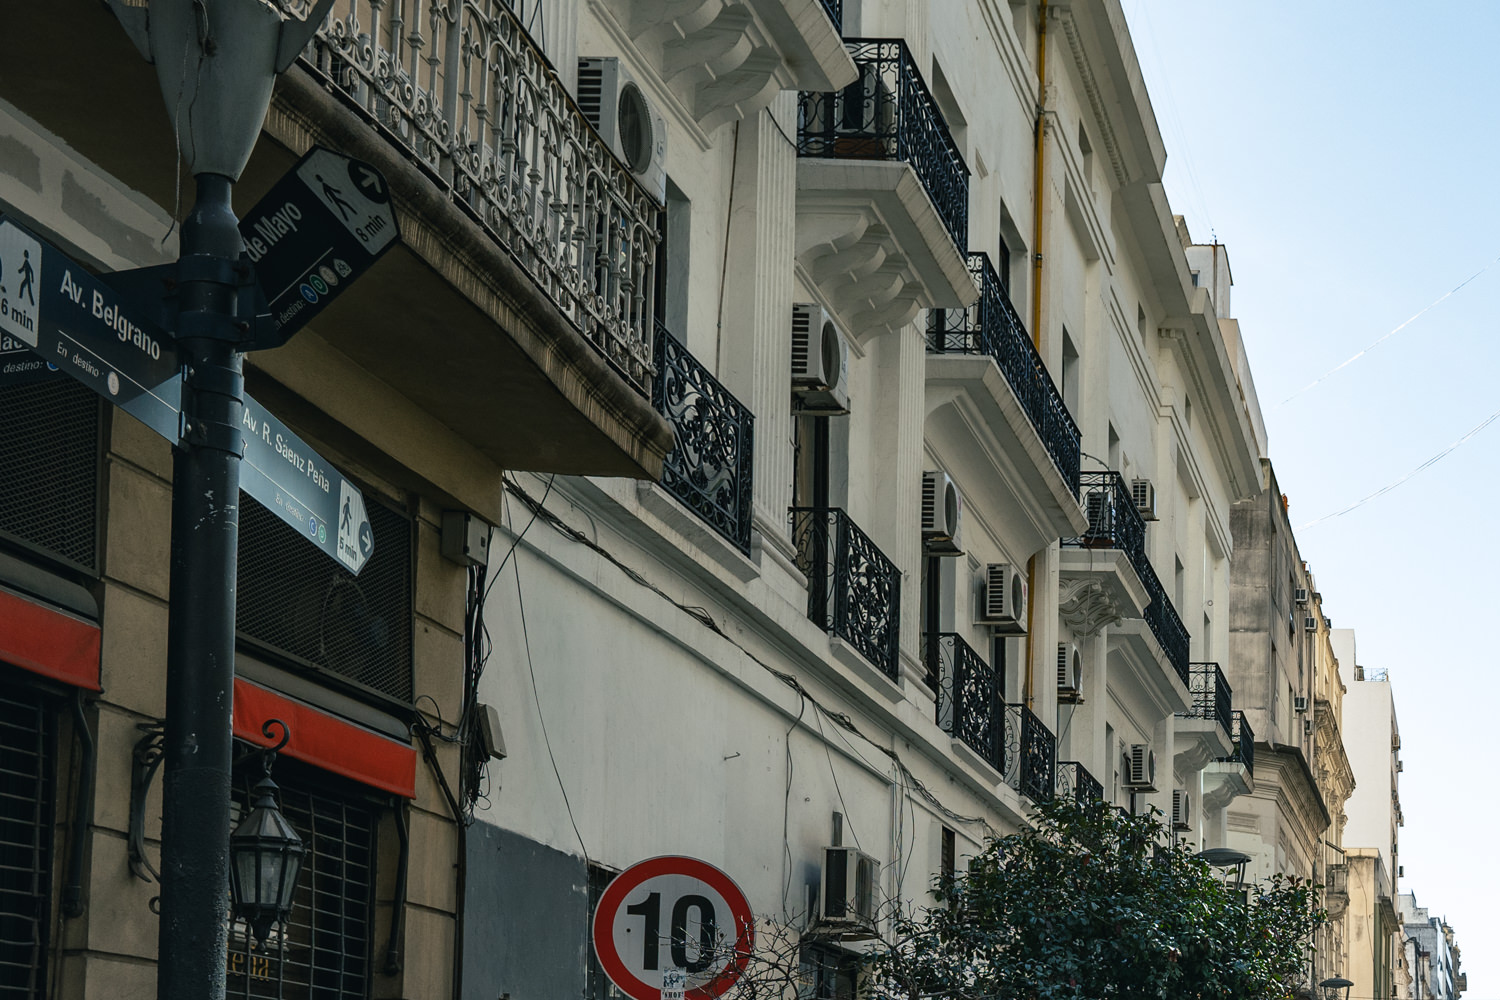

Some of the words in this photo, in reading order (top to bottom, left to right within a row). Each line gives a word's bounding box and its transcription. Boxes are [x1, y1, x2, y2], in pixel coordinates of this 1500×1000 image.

[254, 202, 302, 246] Mayo
[355, 227, 368, 242] 8
[368, 214, 386, 237] min
[1, 299, 9, 316] 6
[12, 307, 34, 332] min
[60, 269, 86, 309] Av.
[92, 288, 160, 361] Belgrano
[57, 341, 68, 358] En
[242, 408, 258, 435] Av.
[262, 421, 272, 446] R.
[275, 433, 304, 473] Sáenz
[307, 460, 330, 493] Peña
[339, 537, 345, 550] 5
[345, 542, 357, 561] min
[627, 892, 716, 973] 10
